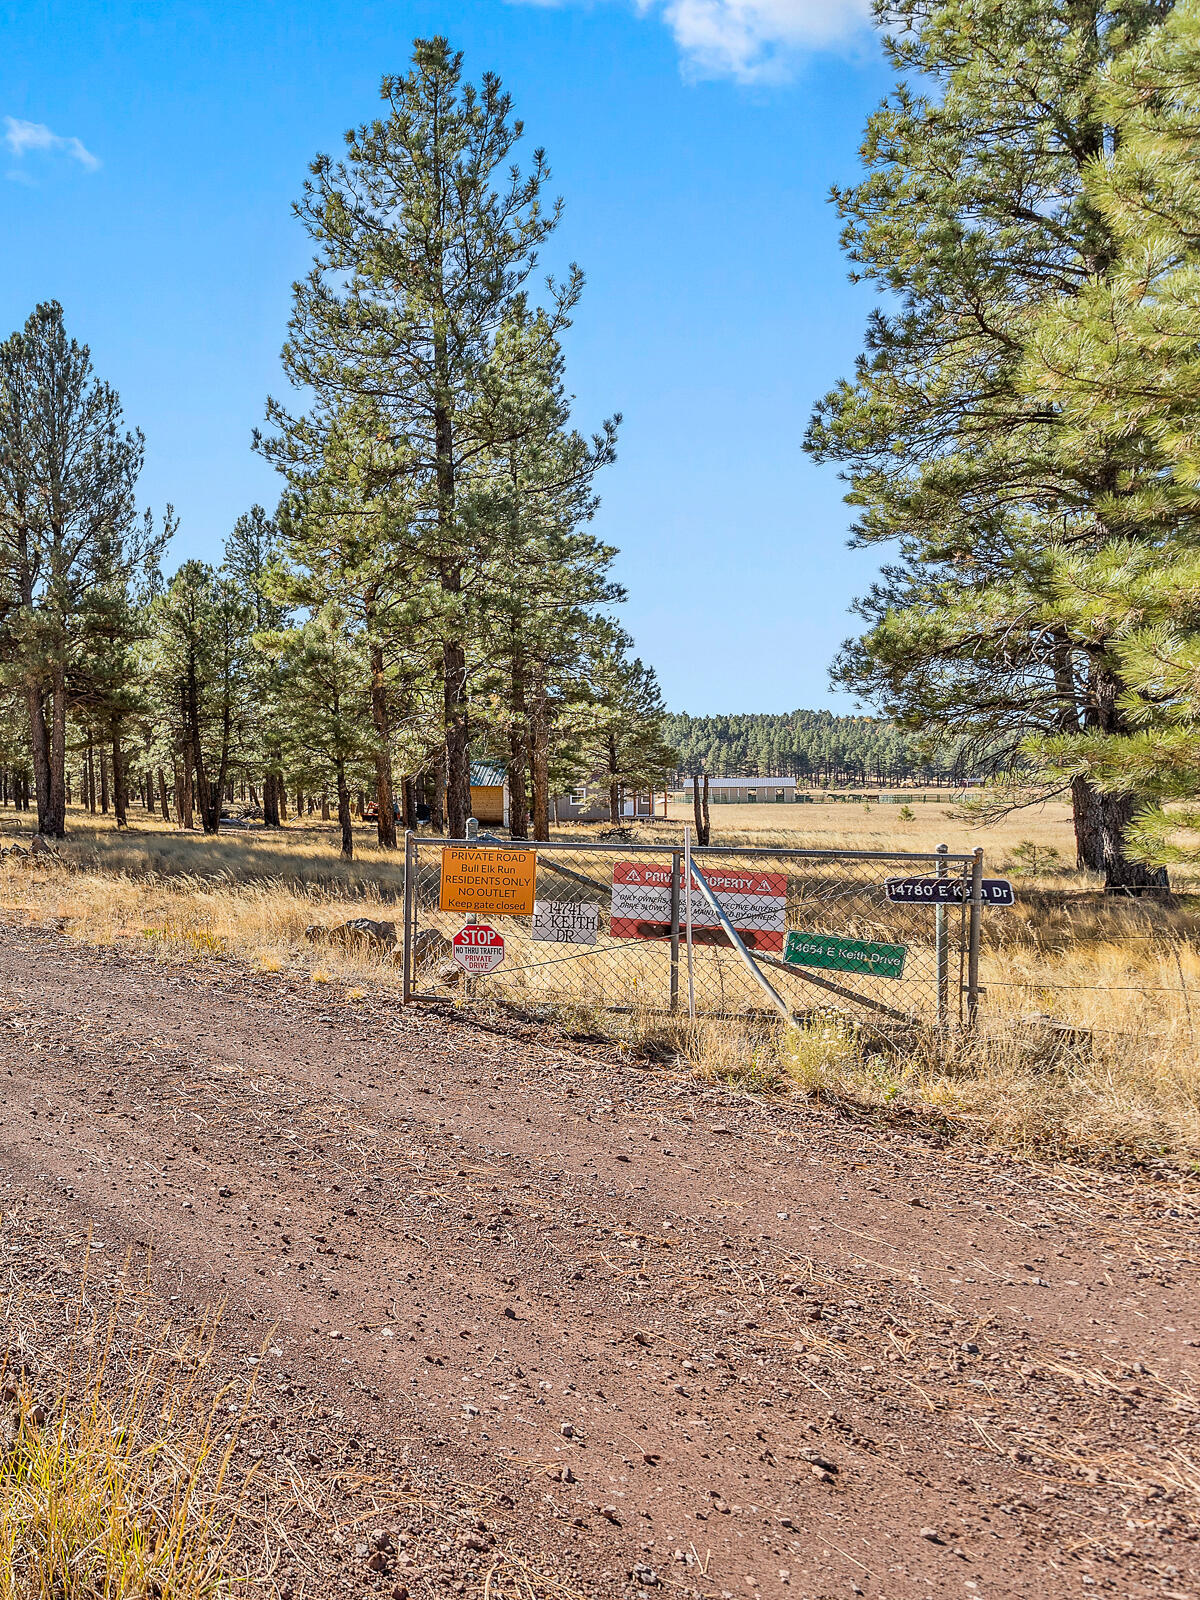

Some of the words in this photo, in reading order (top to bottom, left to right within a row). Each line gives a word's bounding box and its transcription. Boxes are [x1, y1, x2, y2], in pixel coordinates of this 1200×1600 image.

[451, 851, 494, 862] PRIVATE
[496, 853, 527, 863] ROAD
[461, 863, 479, 873] Bull
[481, 864, 495, 873] Elk
[497, 865, 516, 874] Run
[445, 875, 501, 886] RESIDENTS
[502, 877, 531, 887] ONLY
[458, 887, 475, 896] NO
[476, 889, 517, 899] OUTLET
[890, 885, 933, 896] 14780
[938, 885, 948, 897] E
[992, 887, 1009, 898] Dr
[448, 898, 473, 910] Keep
[473, 901, 495, 910] gate
[496, 901, 526, 911] closed
[549, 902, 581, 915] 14741
[534, 915, 543, 927] E
[550, 915, 596, 930] KEITH
[461, 929, 496, 945] STOP
[556, 929, 576, 943] DR
[455, 946, 464, 954] NO
[464, 946, 479, 955] THRU
[480, 947, 502, 955] TRAFFIC
[790, 942, 823, 955] 14654
[827, 947, 835, 957] E
[838, 949, 867, 960] Keith
[870, 953, 901, 966] Drive
[465, 955, 492, 963] PRIVATE
